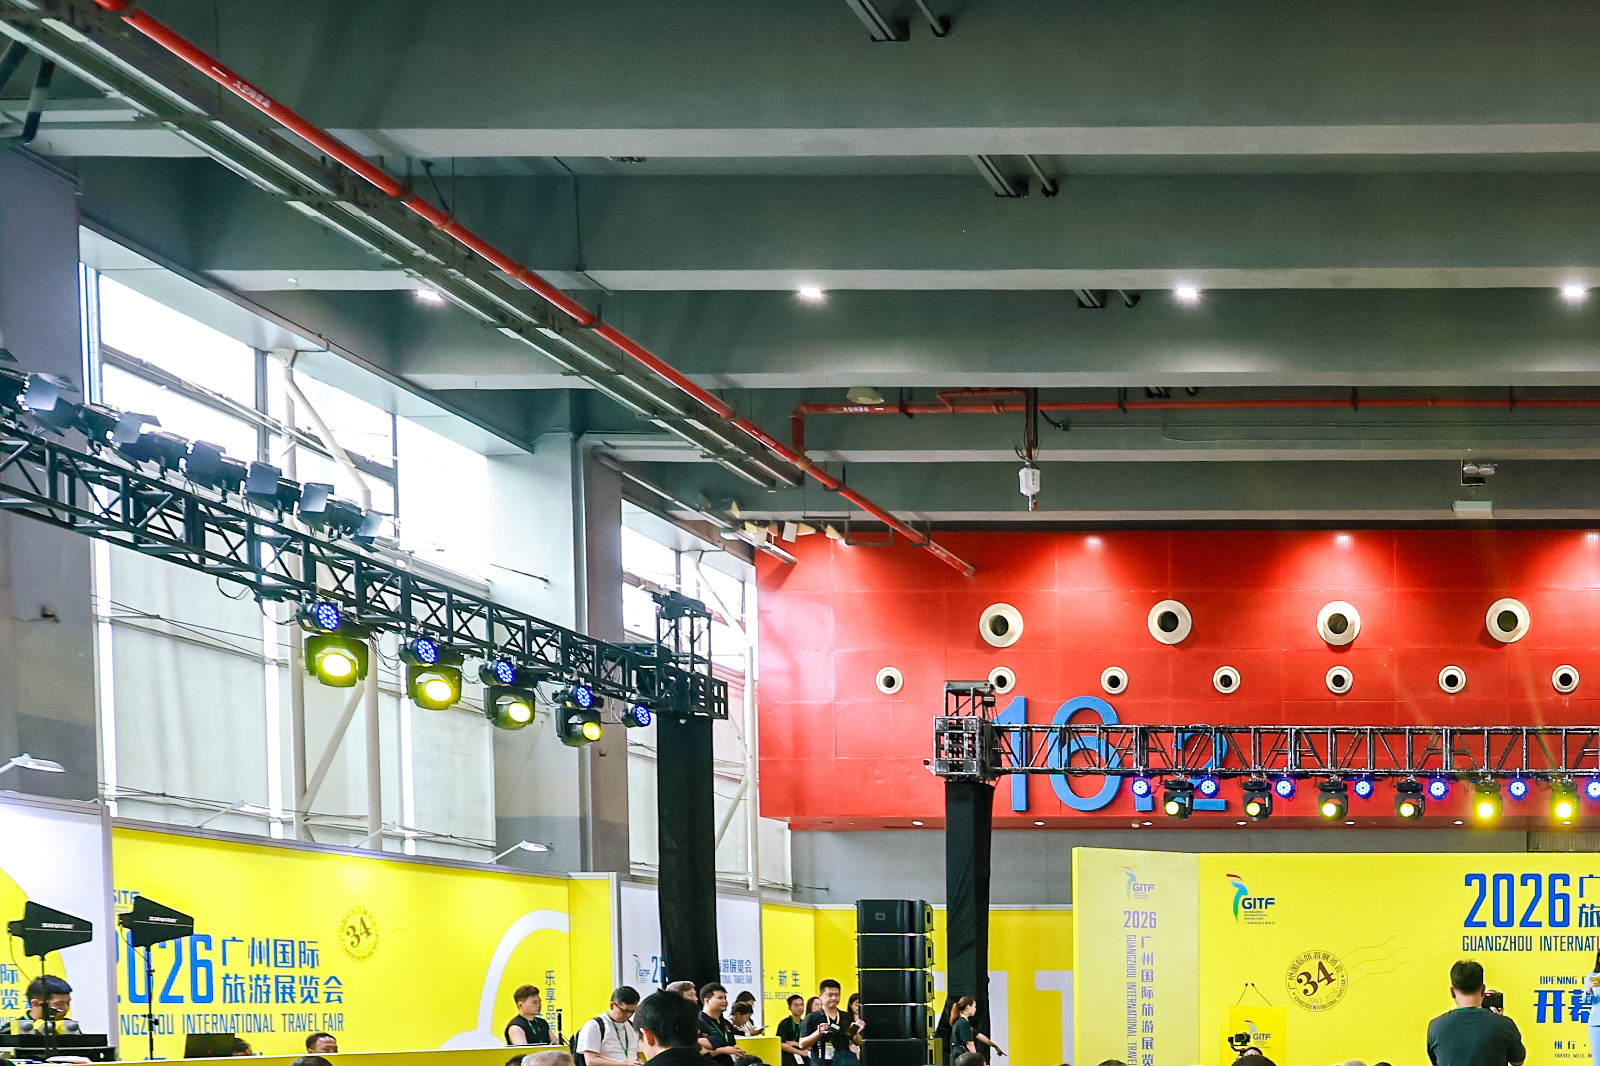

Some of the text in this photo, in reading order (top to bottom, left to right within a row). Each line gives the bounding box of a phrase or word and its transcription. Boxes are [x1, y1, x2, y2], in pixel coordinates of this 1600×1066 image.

[1133, 883, 1155, 892] GITF
[1464, 873, 1571, 928] 2026
[1242, 897, 1276, 910] GITF
[346, 916, 373, 948] 34
[1123, 910, 1157, 929] 2026
[222, 936, 320, 969] 广州国际
[1126, 934, 1137, 978] GUANGZHOU
[1462, 935, 1532, 952] GUANGZHOU
[114, 933, 214, 1004] 026
[1297, 960, 1337, 997] 34
[1540, 976, 1578, 985] OPENING
[222, 974, 344, 1004] 旅游展览会
[182, 1013, 275, 1034] INTERNATIONAL
[281, 1013, 320, 1032] TRAVEL
[323, 1012, 344, 1032] FAIR
[1126, 982, 1138, 1038] INTERNATIONAL
[1252, 1033, 1272, 1041] GITF
